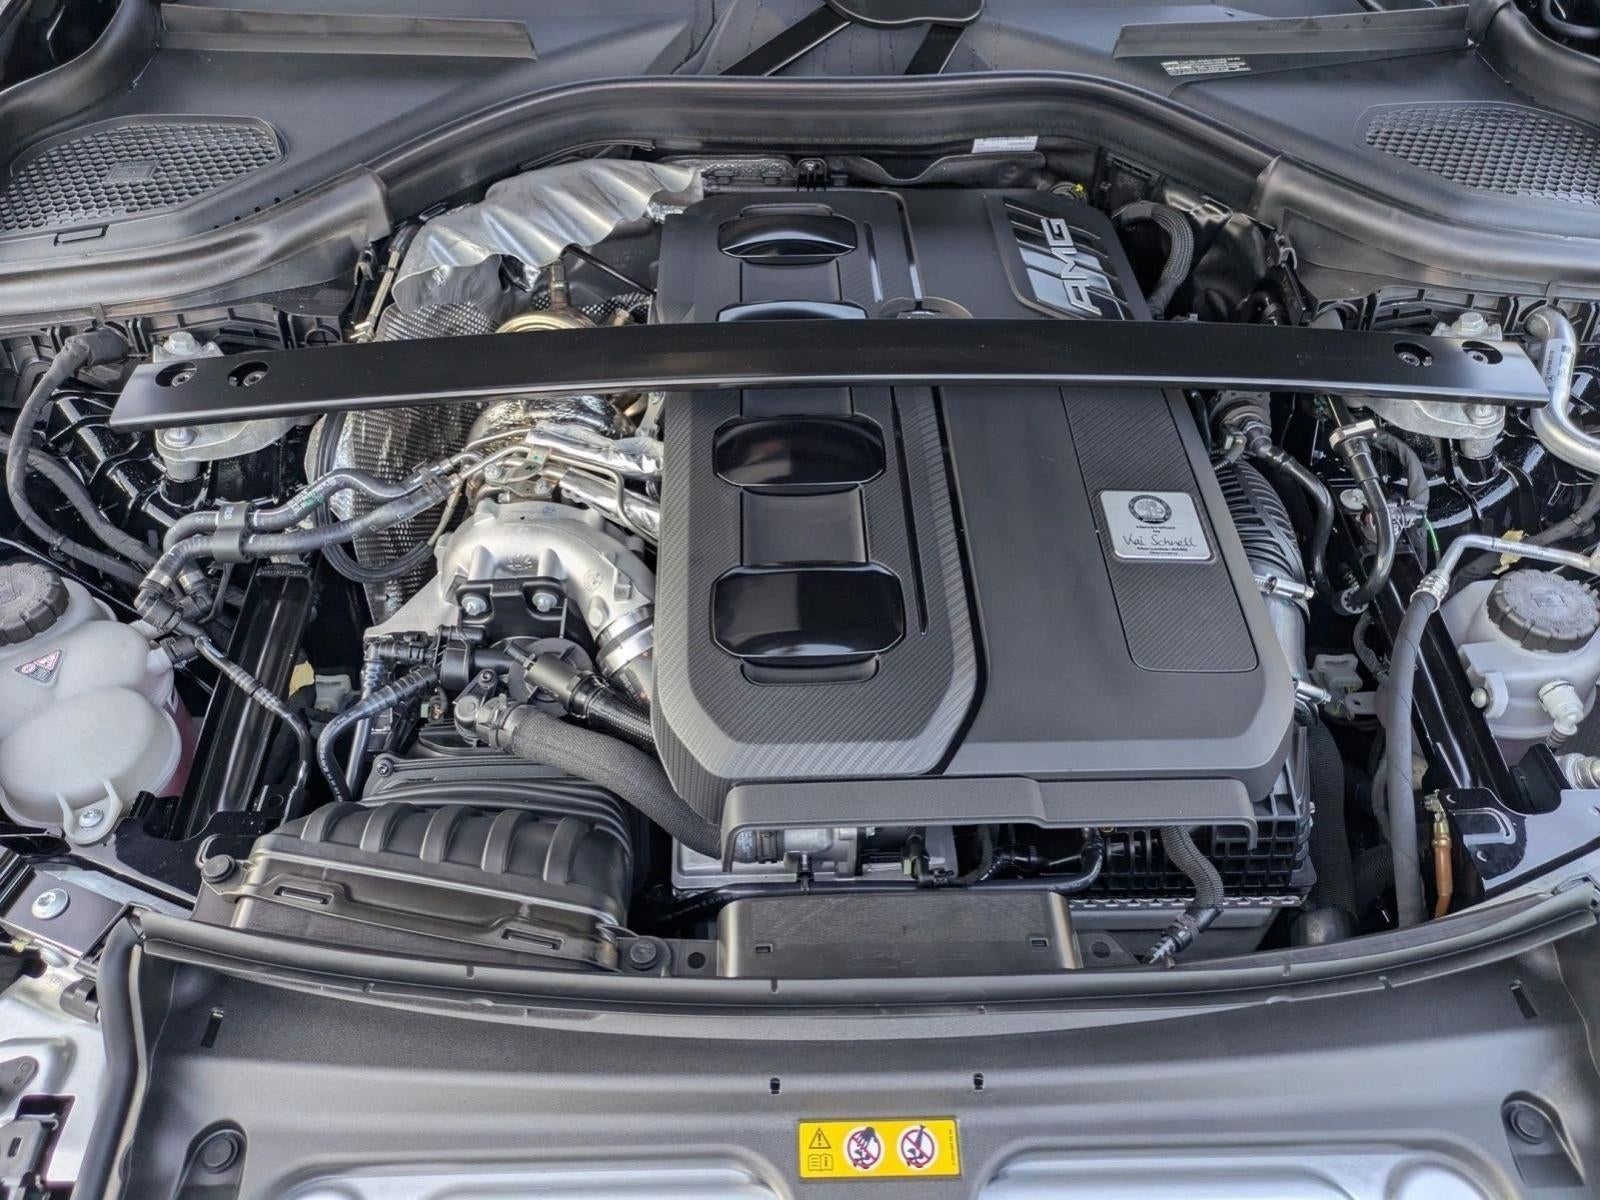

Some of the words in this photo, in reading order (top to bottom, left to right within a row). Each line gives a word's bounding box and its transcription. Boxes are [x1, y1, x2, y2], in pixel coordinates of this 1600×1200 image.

[1040, 217, 1103, 316] AMG
[1122, 533, 1146, 547] Kai
[1150, 533, 1198, 548] Schnell
